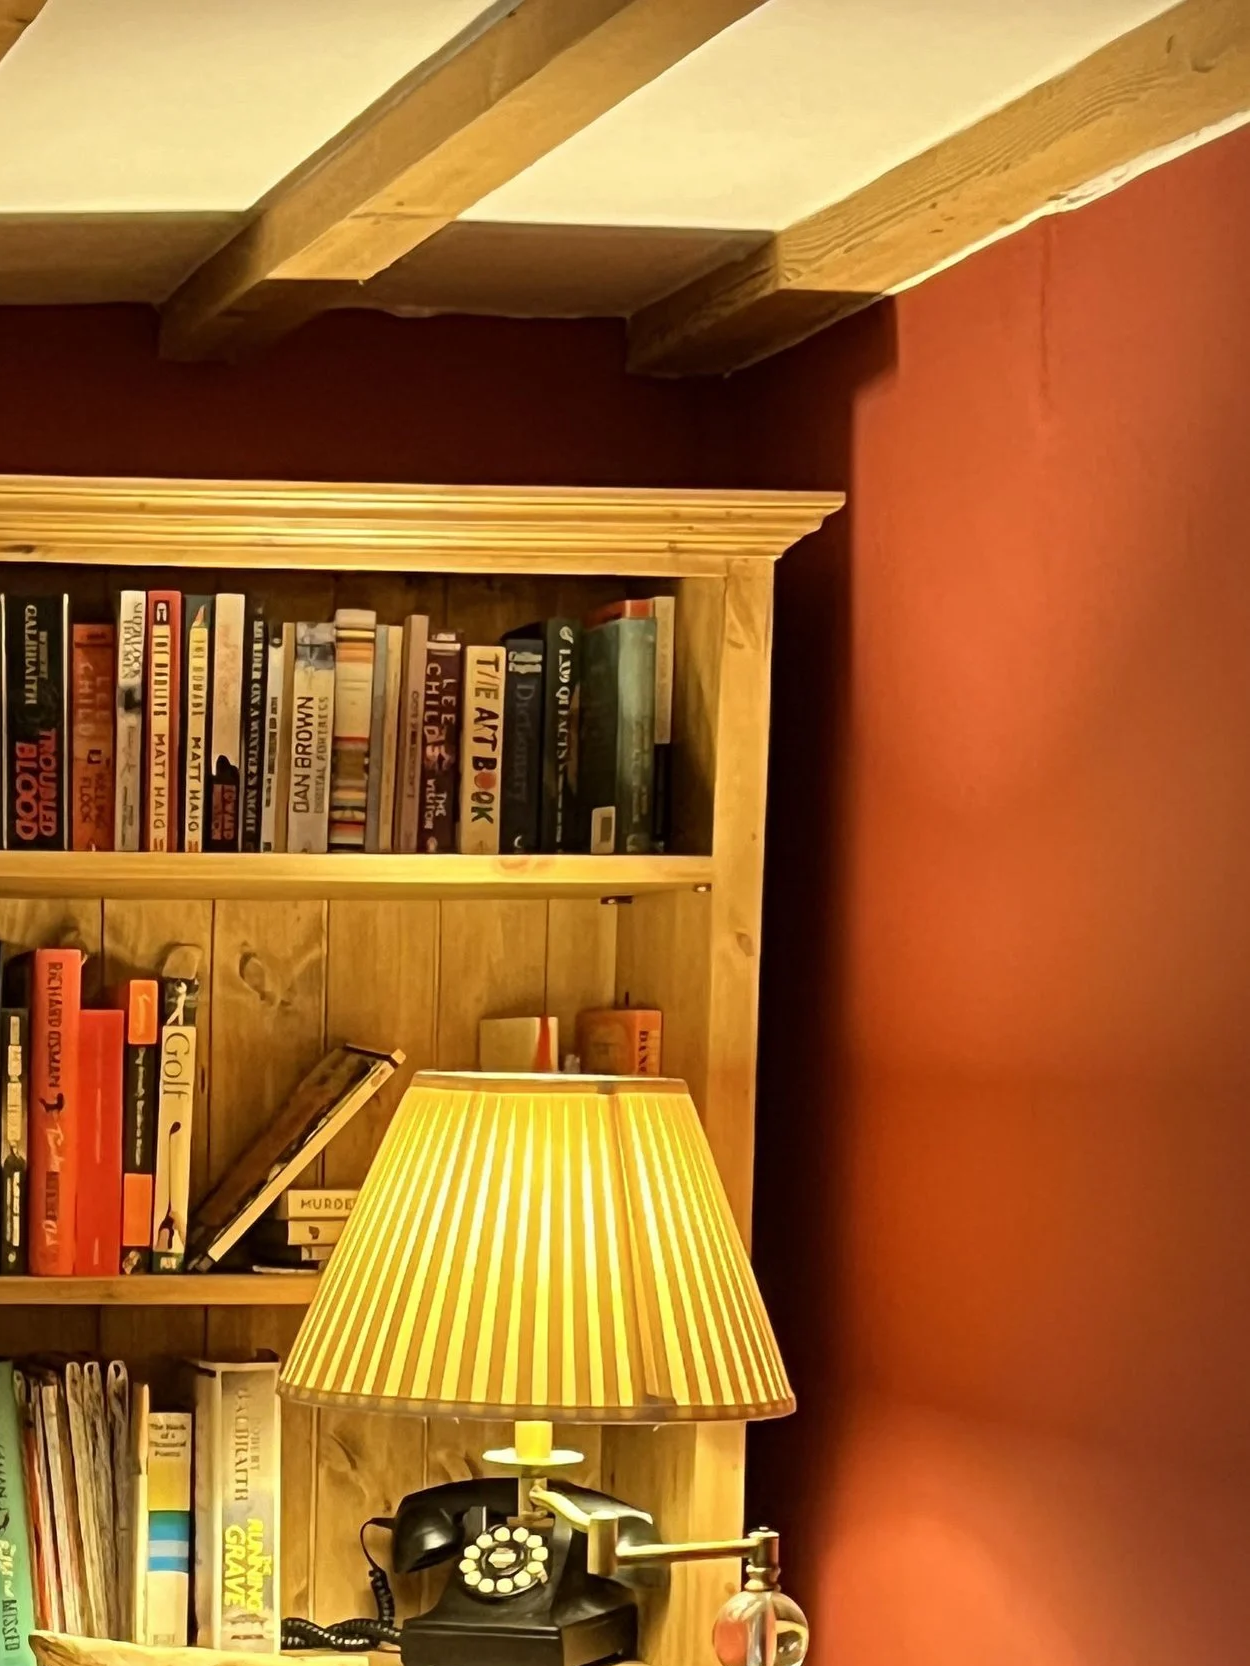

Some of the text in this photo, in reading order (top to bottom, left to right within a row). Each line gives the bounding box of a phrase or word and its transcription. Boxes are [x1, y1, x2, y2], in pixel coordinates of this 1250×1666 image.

[24, 604, 38, 705] GALBRAITH
[153, 634, 169, 656] THE
[192, 639, 206, 660] THE
[252, 620, 266, 678] MURDER
[77, 662, 94, 736] CHILD
[315, 695, 329, 763] FORTRESS
[423, 662, 443, 740] CHILD
[440, 678, 457, 726] LEE
[554, 686, 572, 706] QI
[153, 733, 165, 780] MATT
[189, 736, 202, 783] MATT
[293, 695, 313, 814] DAN BROWN
[470, 653, 500, 825] THE ART BOOK
[507, 682, 537, 804] Dictionary
[14, 740, 38, 841] BLOOD
[38, 727, 58, 837] TROUBLED
[152, 786, 165, 830] HAIG
[187, 789, 200, 833] HAIG
[246, 789, 258, 834] NIGHT
[423, 778, 436, 829] VISITOR
[436, 791, 448, 816] THE
[47, 961, 64, 1089] RICHARD OSMAN
[162, 1031, 191, 1104] Golf
[233, 1388, 250, 1501] GALBRAITH
[223, 1524, 248, 1608] GRAVE
[245, 1518, 265, 1612] RUNNING
[0, 1599, 22, 1651] MISSED
